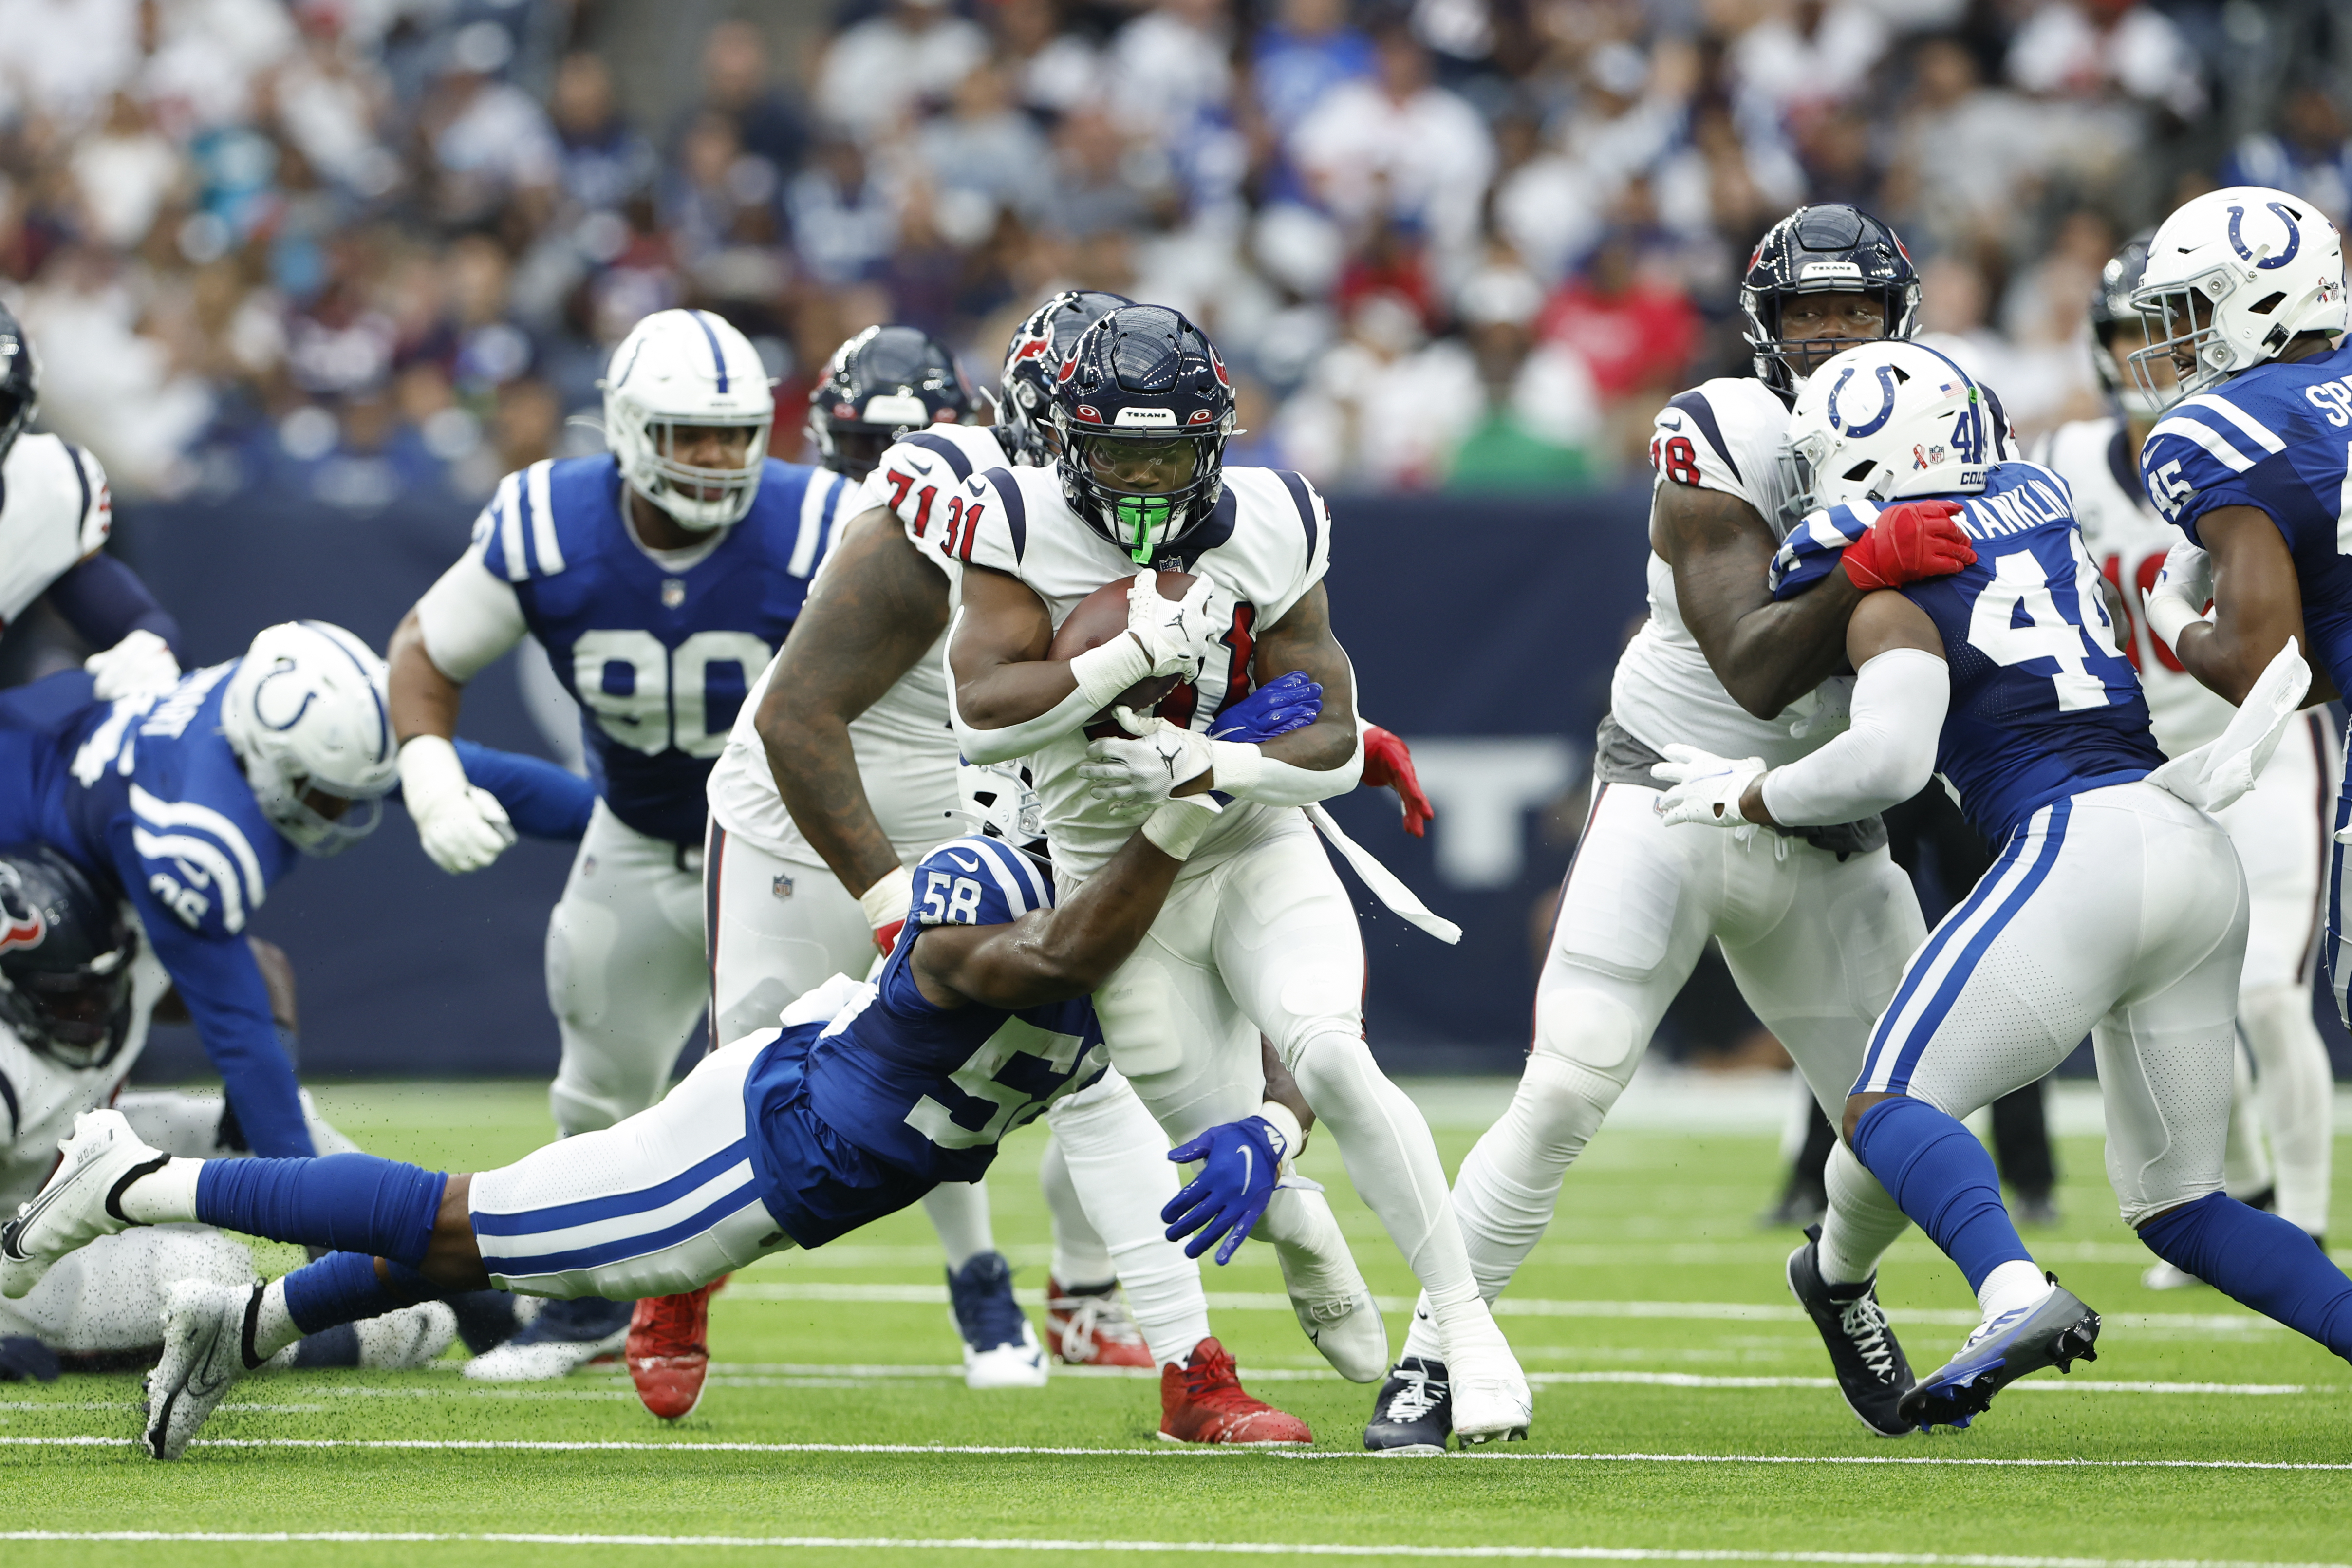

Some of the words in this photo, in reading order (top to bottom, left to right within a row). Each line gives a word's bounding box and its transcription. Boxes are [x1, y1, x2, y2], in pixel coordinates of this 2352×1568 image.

[2305, 374, 2352, 428] SP
[1931, 452, 1944, 462] NFL
[887, 468, 938, 538] 71
[2148, 458, 2200, 521] 45
[939, 495, 985, 562] 31
[572, 629, 771, 759] 90
[919, 871, 982, 925] 58
